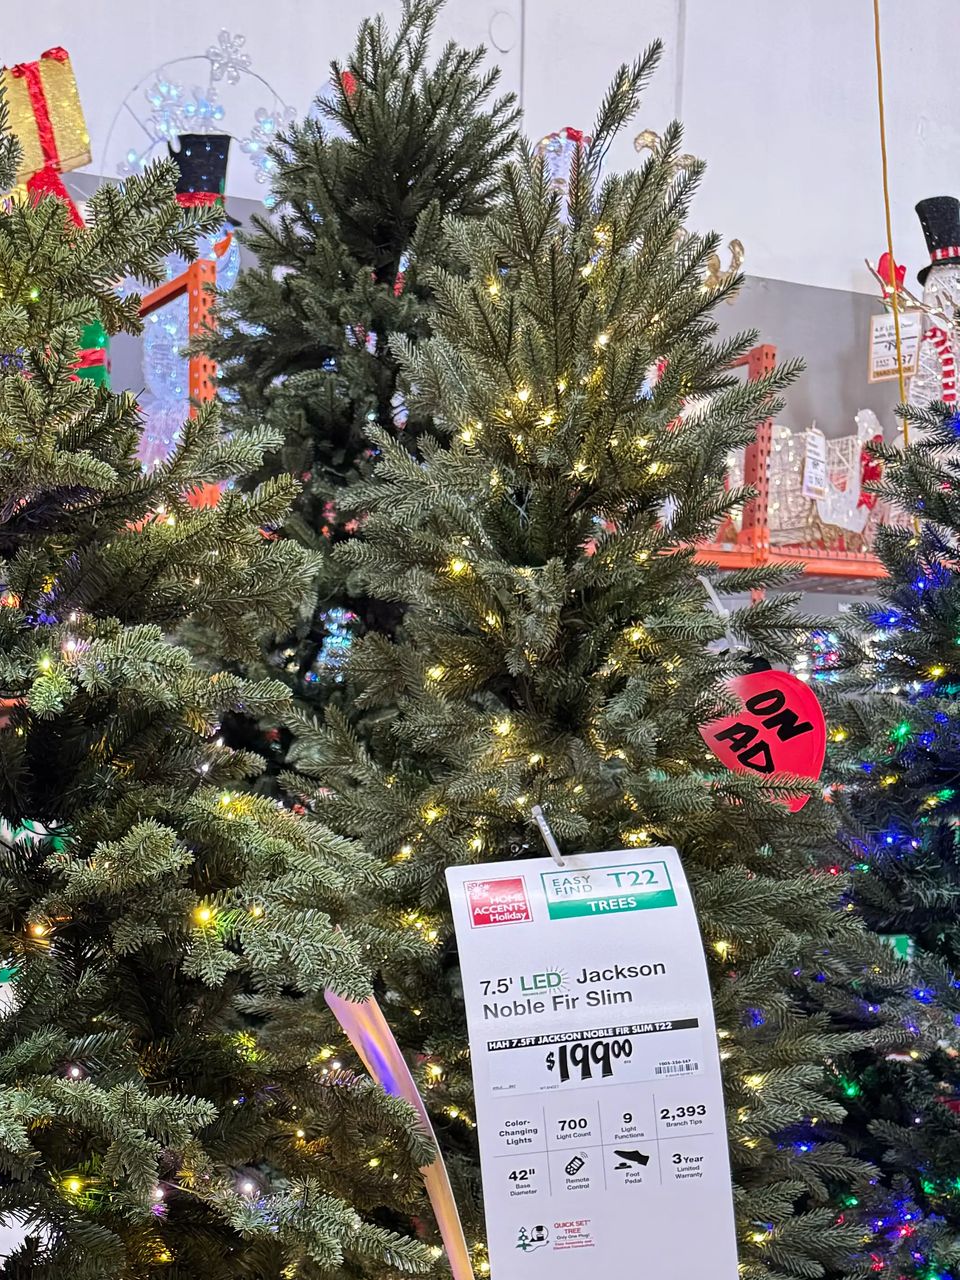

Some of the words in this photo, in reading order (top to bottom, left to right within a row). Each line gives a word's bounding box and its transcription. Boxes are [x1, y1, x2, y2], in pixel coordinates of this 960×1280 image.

[745, 689, 815, 743] ON
[713, 722, 776, 775] AD
[552, 875, 591, 887] EASY
[606, 869, 659, 888] T22
[555, 884, 592, 896] FIND
[489, 892, 526, 904] HOME
[587, 896, 637, 912] TREES
[474, 902, 526, 915] ACCENTS
[489, 911, 527, 922] Holiday
[480, 977, 513, 996] 7.5'
[520, 972, 562, 991] LED
[576, 962, 666, 984] Jackson
[483, 998, 545, 1020] Noble
[552, 994, 579, 1011] Fir
[586, 989, 632, 1007] Slim
[489, 1040, 510, 1050] HAH
[512, 1037, 536, 1047] 7.5FT
[537, 1032, 581, 1044] JACKSON
[583, 1028, 614, 1040] NOBLE
[616, 1026, 630, 1036] FIR
[632, 1023, 653, 1034] SLIM
[655, 1021, 672, 1031] T22
[623, 1113, 633, 1124] 9
[660, 1104, 706, 1121] 2,393
[558, 1118, 587, 1131] 700
[666, 1120, 689, 1128] Branch
[499, 1128, 538, 1137] Changing
[614, 1132, 645, 1140] Functions
[506, 1137, 533, 1145] Lights
[672, 1153, 682, 1164] 3
[683, 1156, 704, 1164] Year
[508, 1169, 535, 1181] 42"
[510, 1189, 538, 1197] Diameter
[553, 1221, 575, 1229] QUICK
